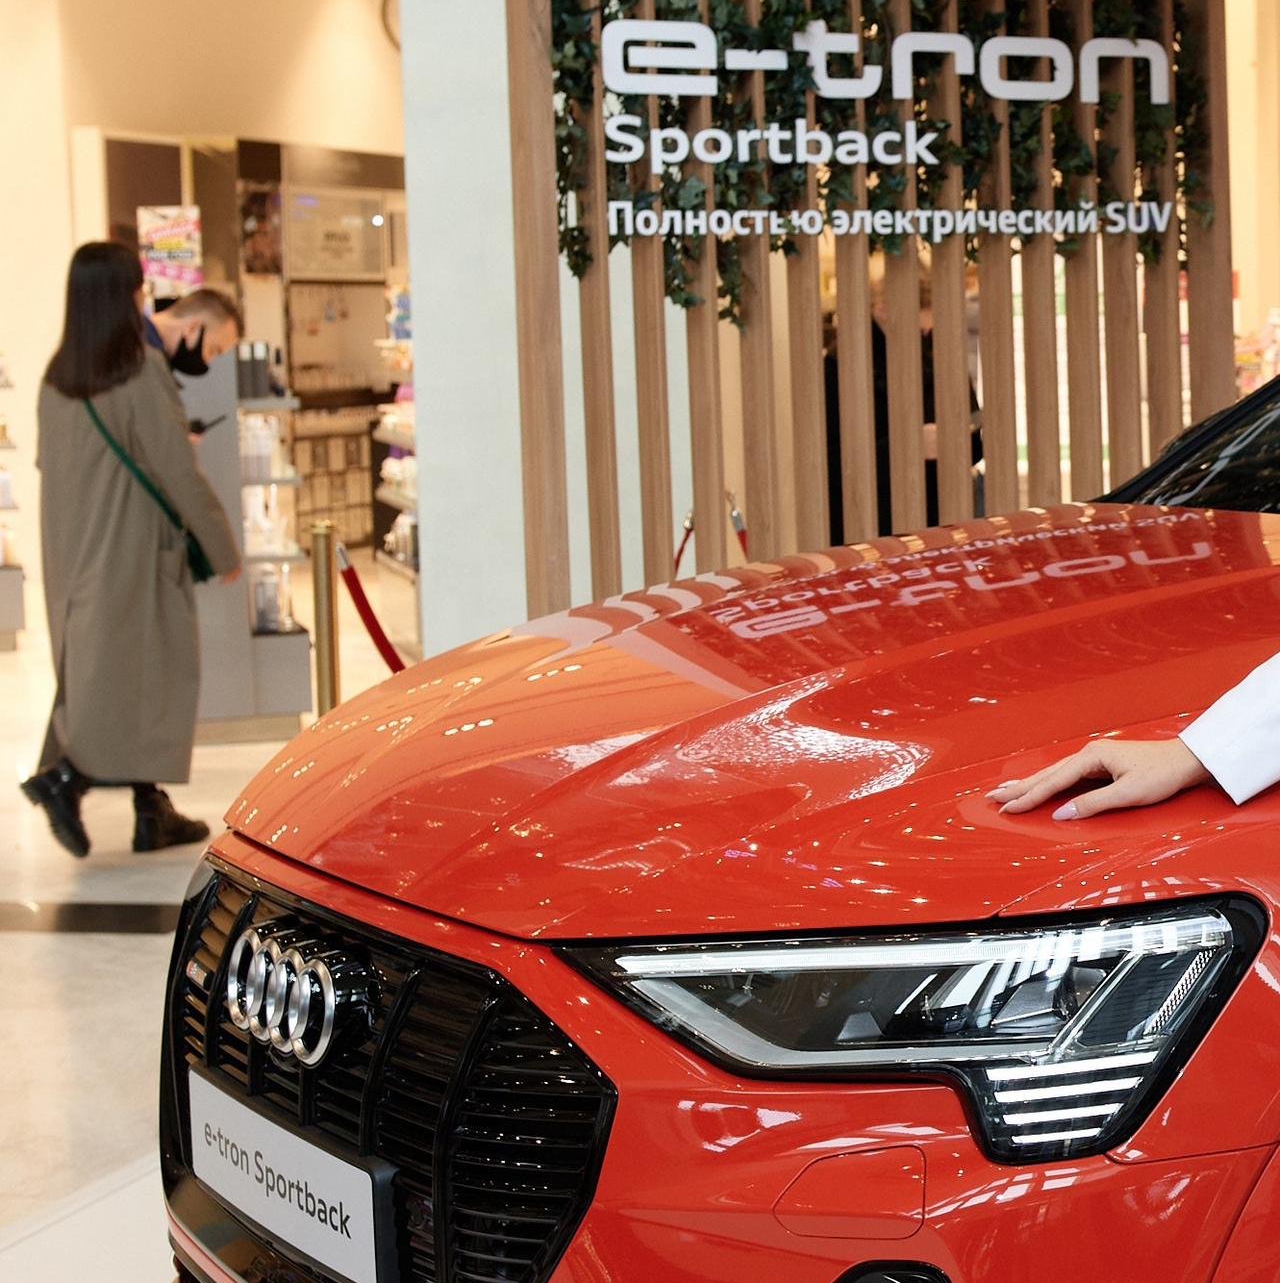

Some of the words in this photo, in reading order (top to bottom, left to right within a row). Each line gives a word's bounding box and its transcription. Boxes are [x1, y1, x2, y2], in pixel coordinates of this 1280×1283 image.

[601, 18, 1171, 105] e-tron
[603, 113, 940, 176] Sportback
[607, 200, 823, 236] Полностью
[831, 200, 1098, 244] электрический
[1105, 200, 1173, 234] SUV
[204, 1122, 249, 1175] e-tron
[254, 1150, 352, 1239] Sportback
